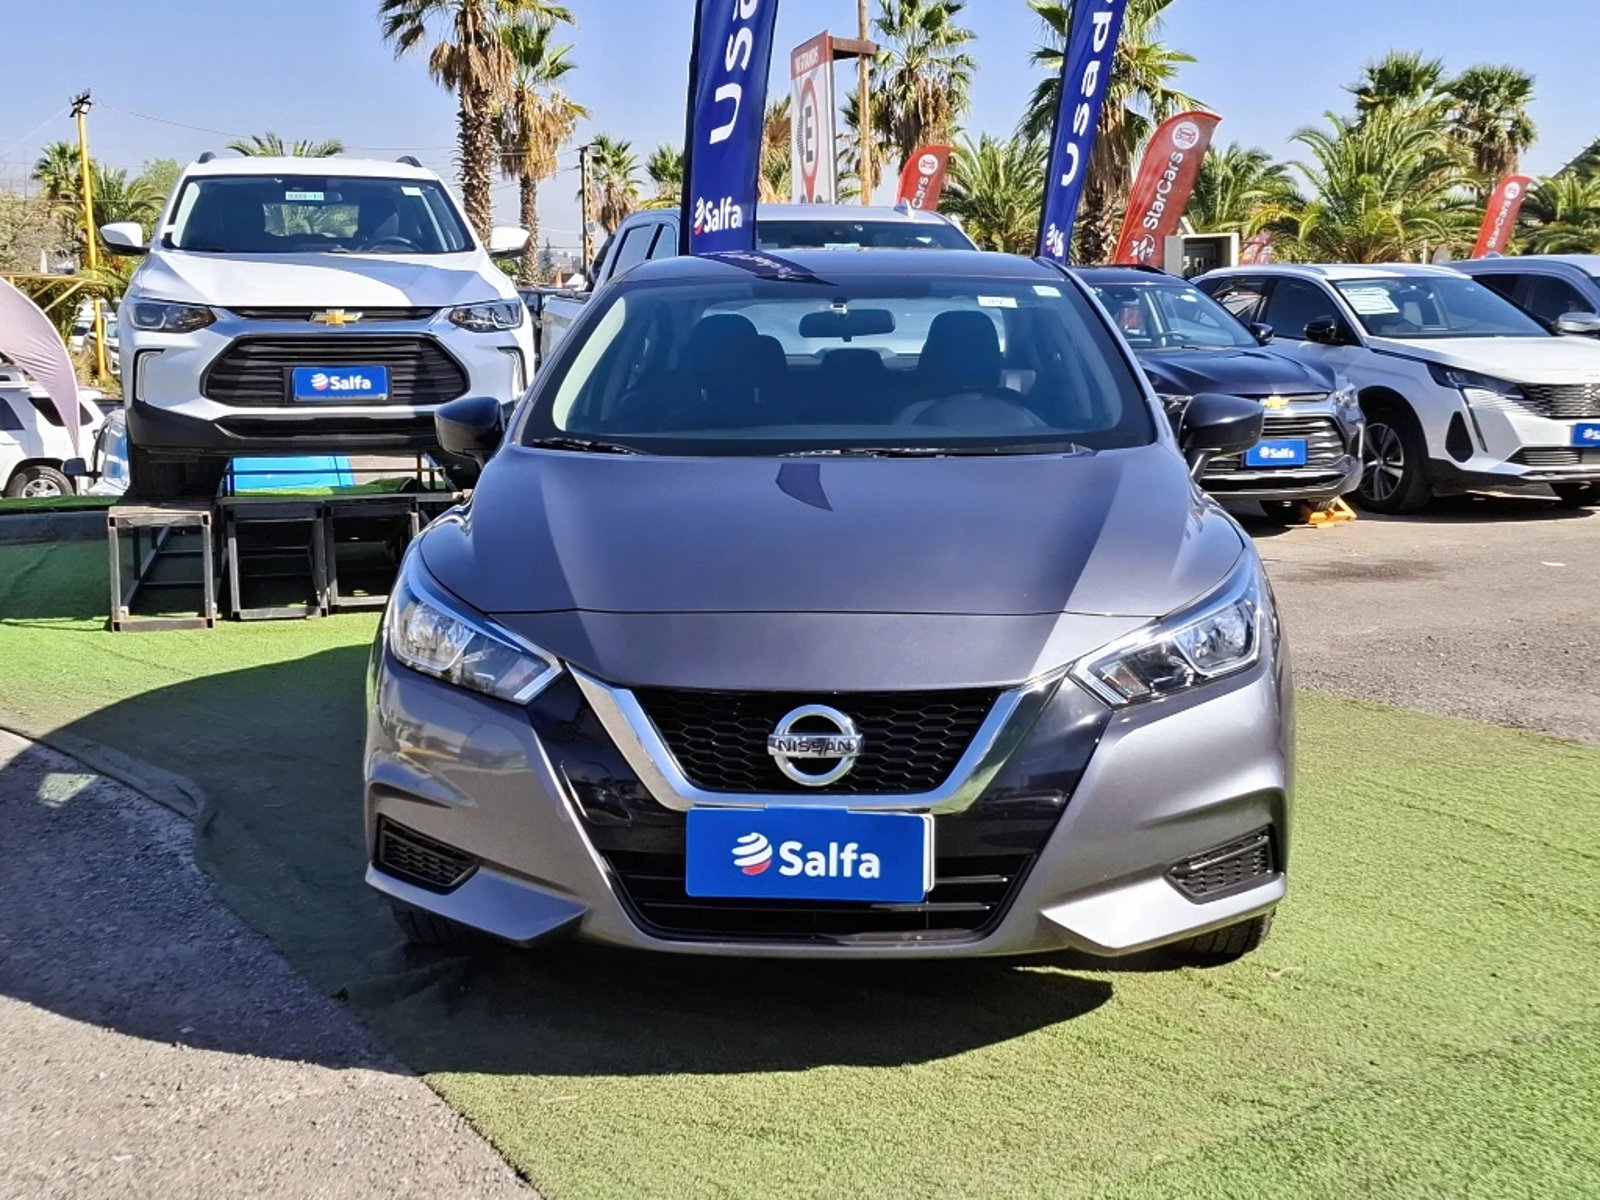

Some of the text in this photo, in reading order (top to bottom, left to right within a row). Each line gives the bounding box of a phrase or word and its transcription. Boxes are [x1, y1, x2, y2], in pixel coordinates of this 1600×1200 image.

[1060, 0, 1113, 187] Usad
[1143, 151, 1184, 231] StarCars
[703, 196, 743, 233] Salfa
[329, 375, 371, 390] Salfa
[777, 740, 852, 753] NISSAN
[779, 840, 880, 879] Salfa
